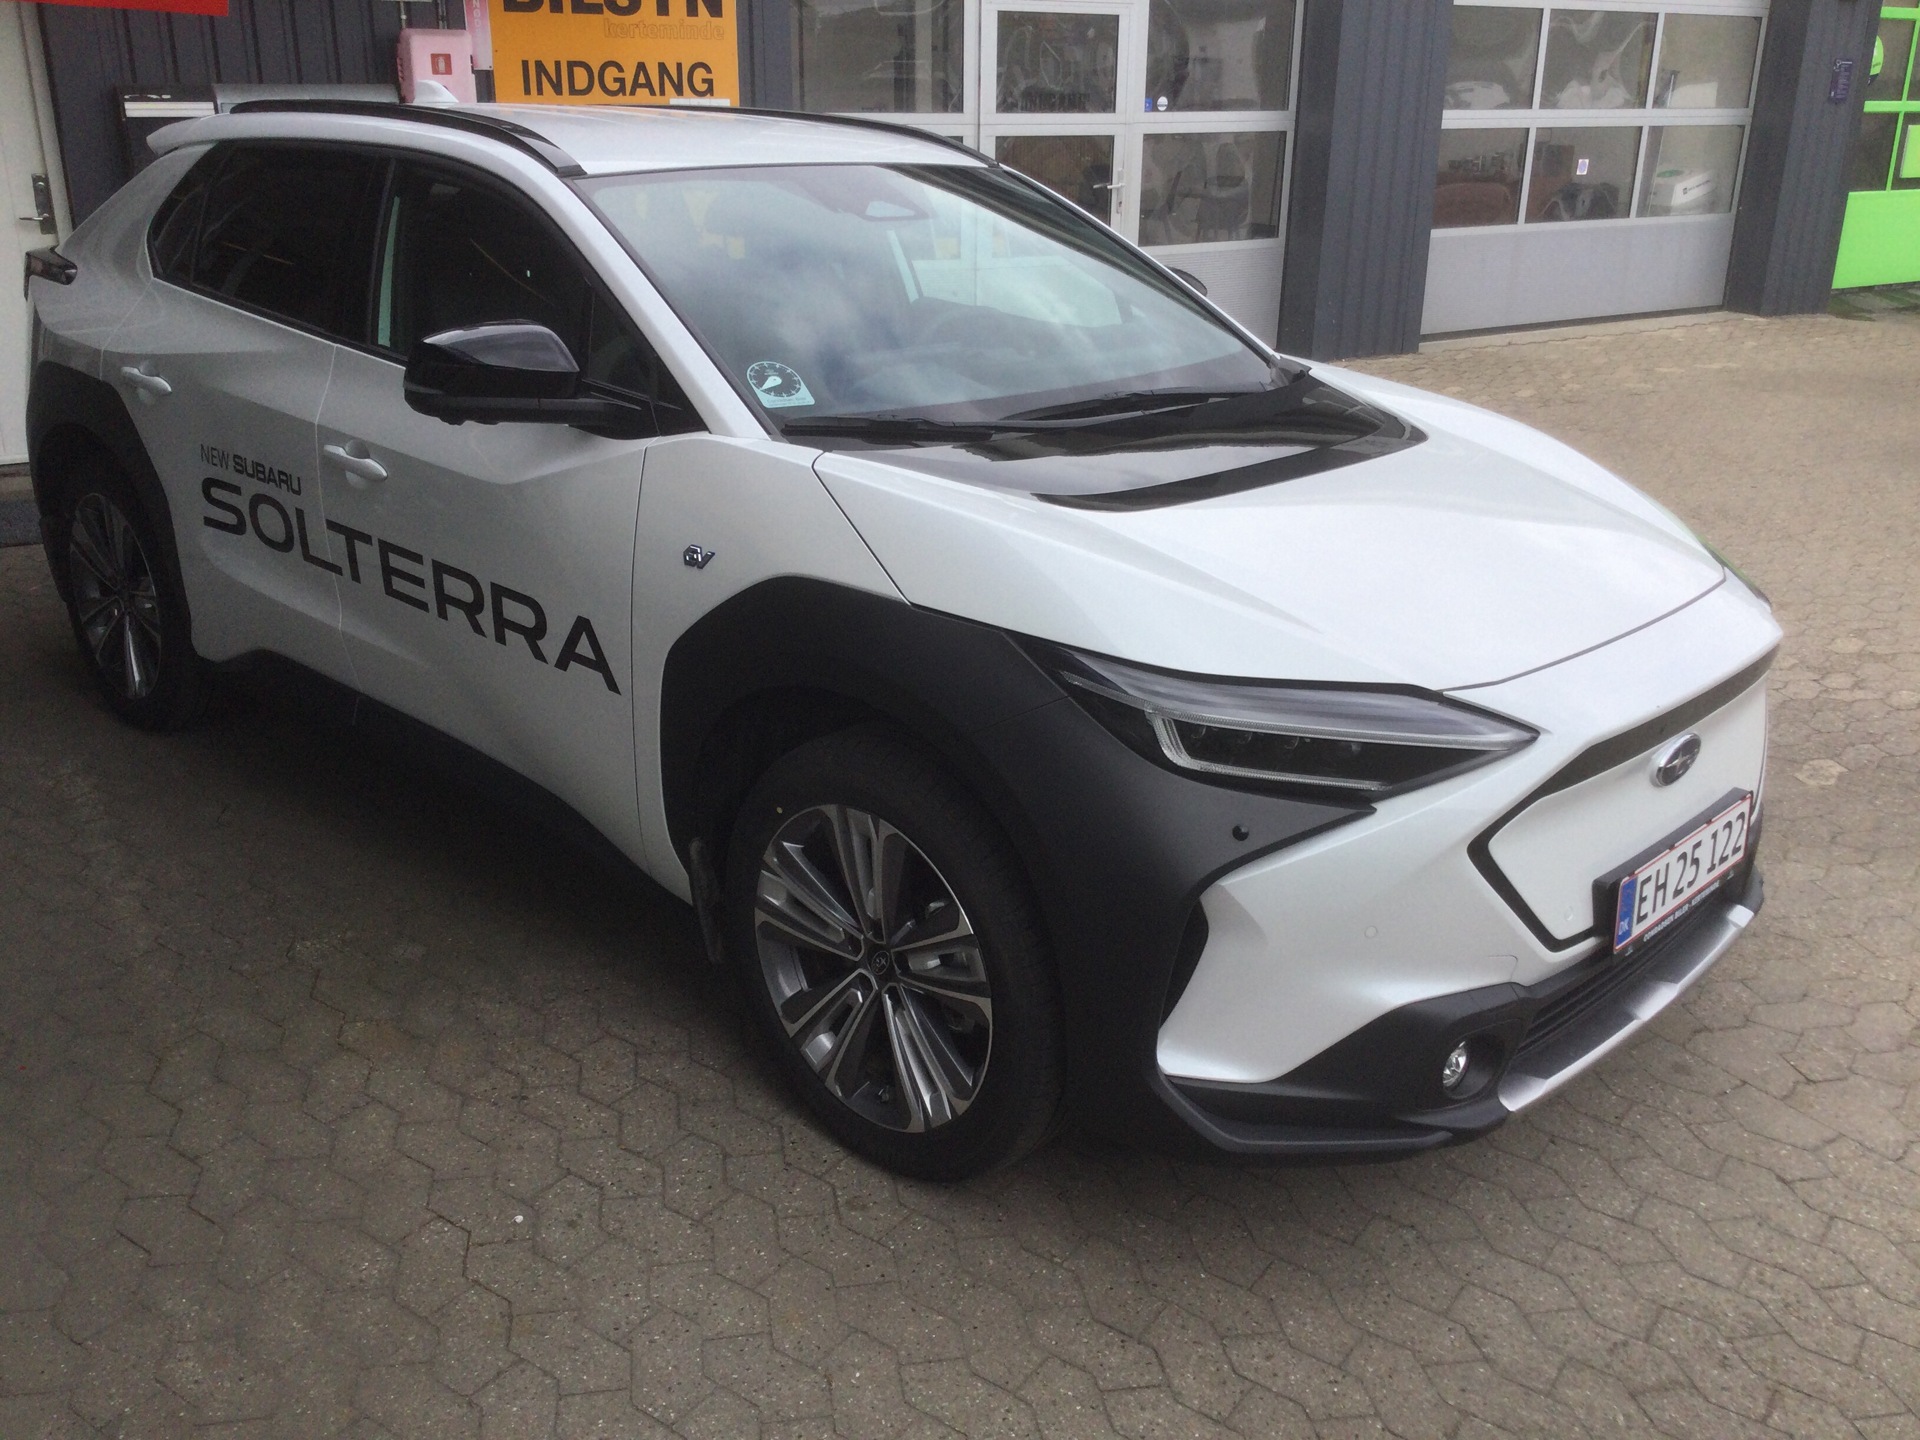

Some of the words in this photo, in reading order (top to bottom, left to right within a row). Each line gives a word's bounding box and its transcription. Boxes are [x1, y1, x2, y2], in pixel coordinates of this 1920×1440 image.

[603, 18, 725, 41] kerteminde
[521, 59, 714, 97] INDGANG
[200, 443, 229, 470] NEW
[233, 454, 302, 496] SUBARU
[202, 477, 622, 696] SOLTERRA
[1636, 862, 1670, 925] EH
[1672, 840, 1702, 900] 25
[1706, 811, 1746, 875] 122
